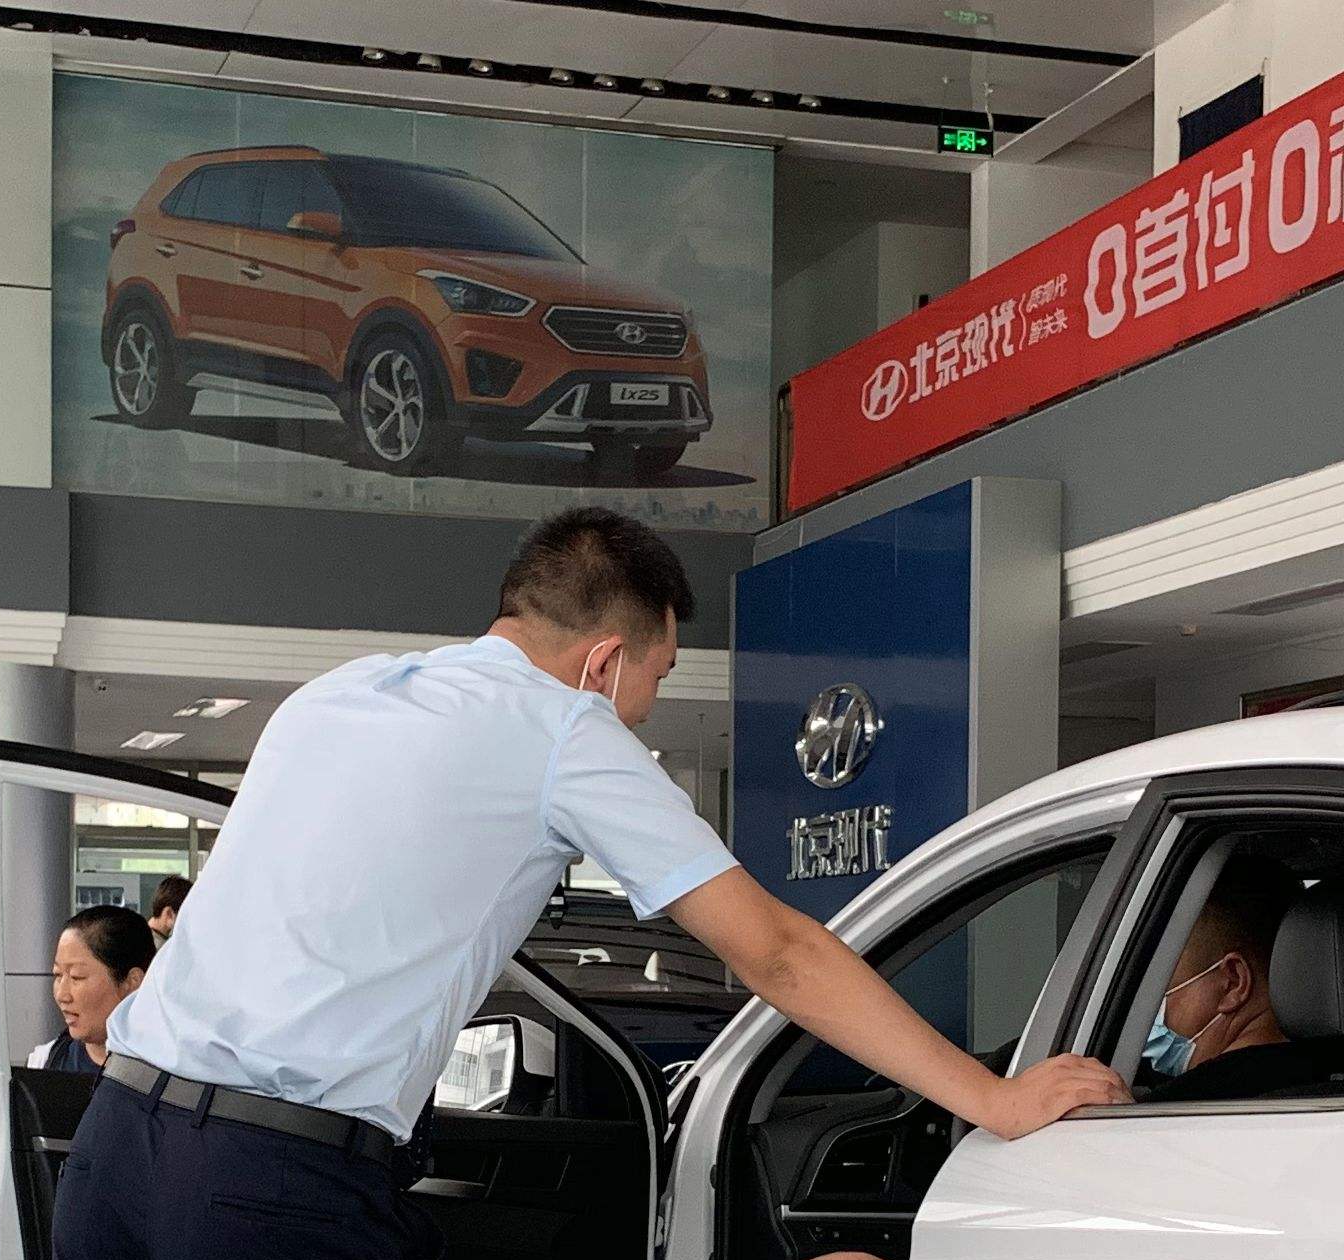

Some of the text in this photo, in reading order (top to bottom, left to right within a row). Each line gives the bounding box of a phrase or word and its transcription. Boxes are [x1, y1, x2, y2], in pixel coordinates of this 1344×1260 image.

[909, 299, 1017, 403] 北京现代
[786, 804, 892, 881] 北京现代
